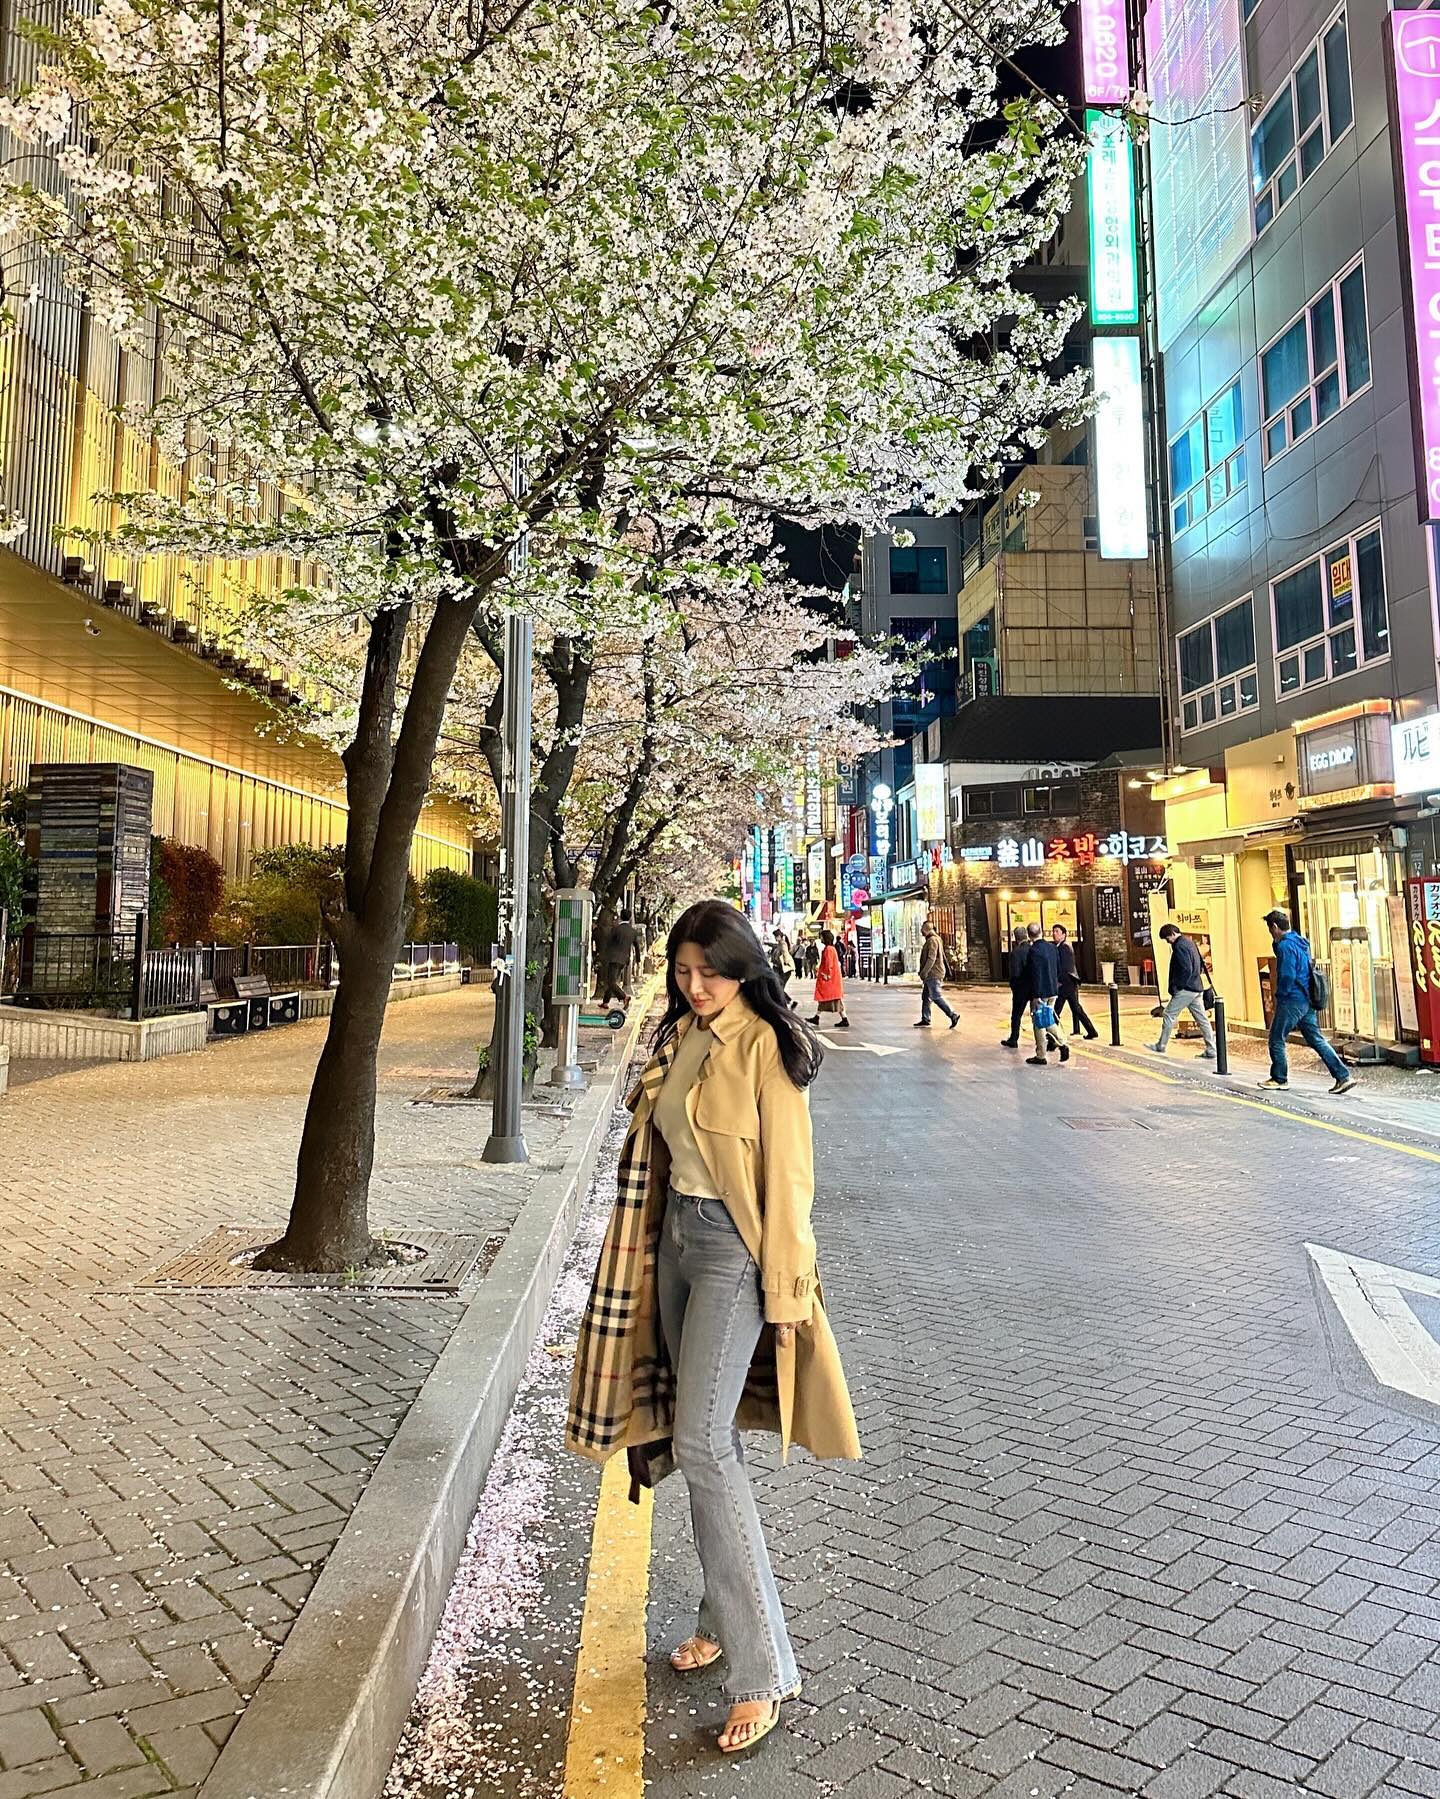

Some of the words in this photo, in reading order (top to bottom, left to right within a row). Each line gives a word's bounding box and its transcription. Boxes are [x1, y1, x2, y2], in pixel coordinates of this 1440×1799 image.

[1332, 558, 1351, 588] 임대
[1310, 752, 1329, 771] EGG
[1328, 745, 1354, 767] DROP
